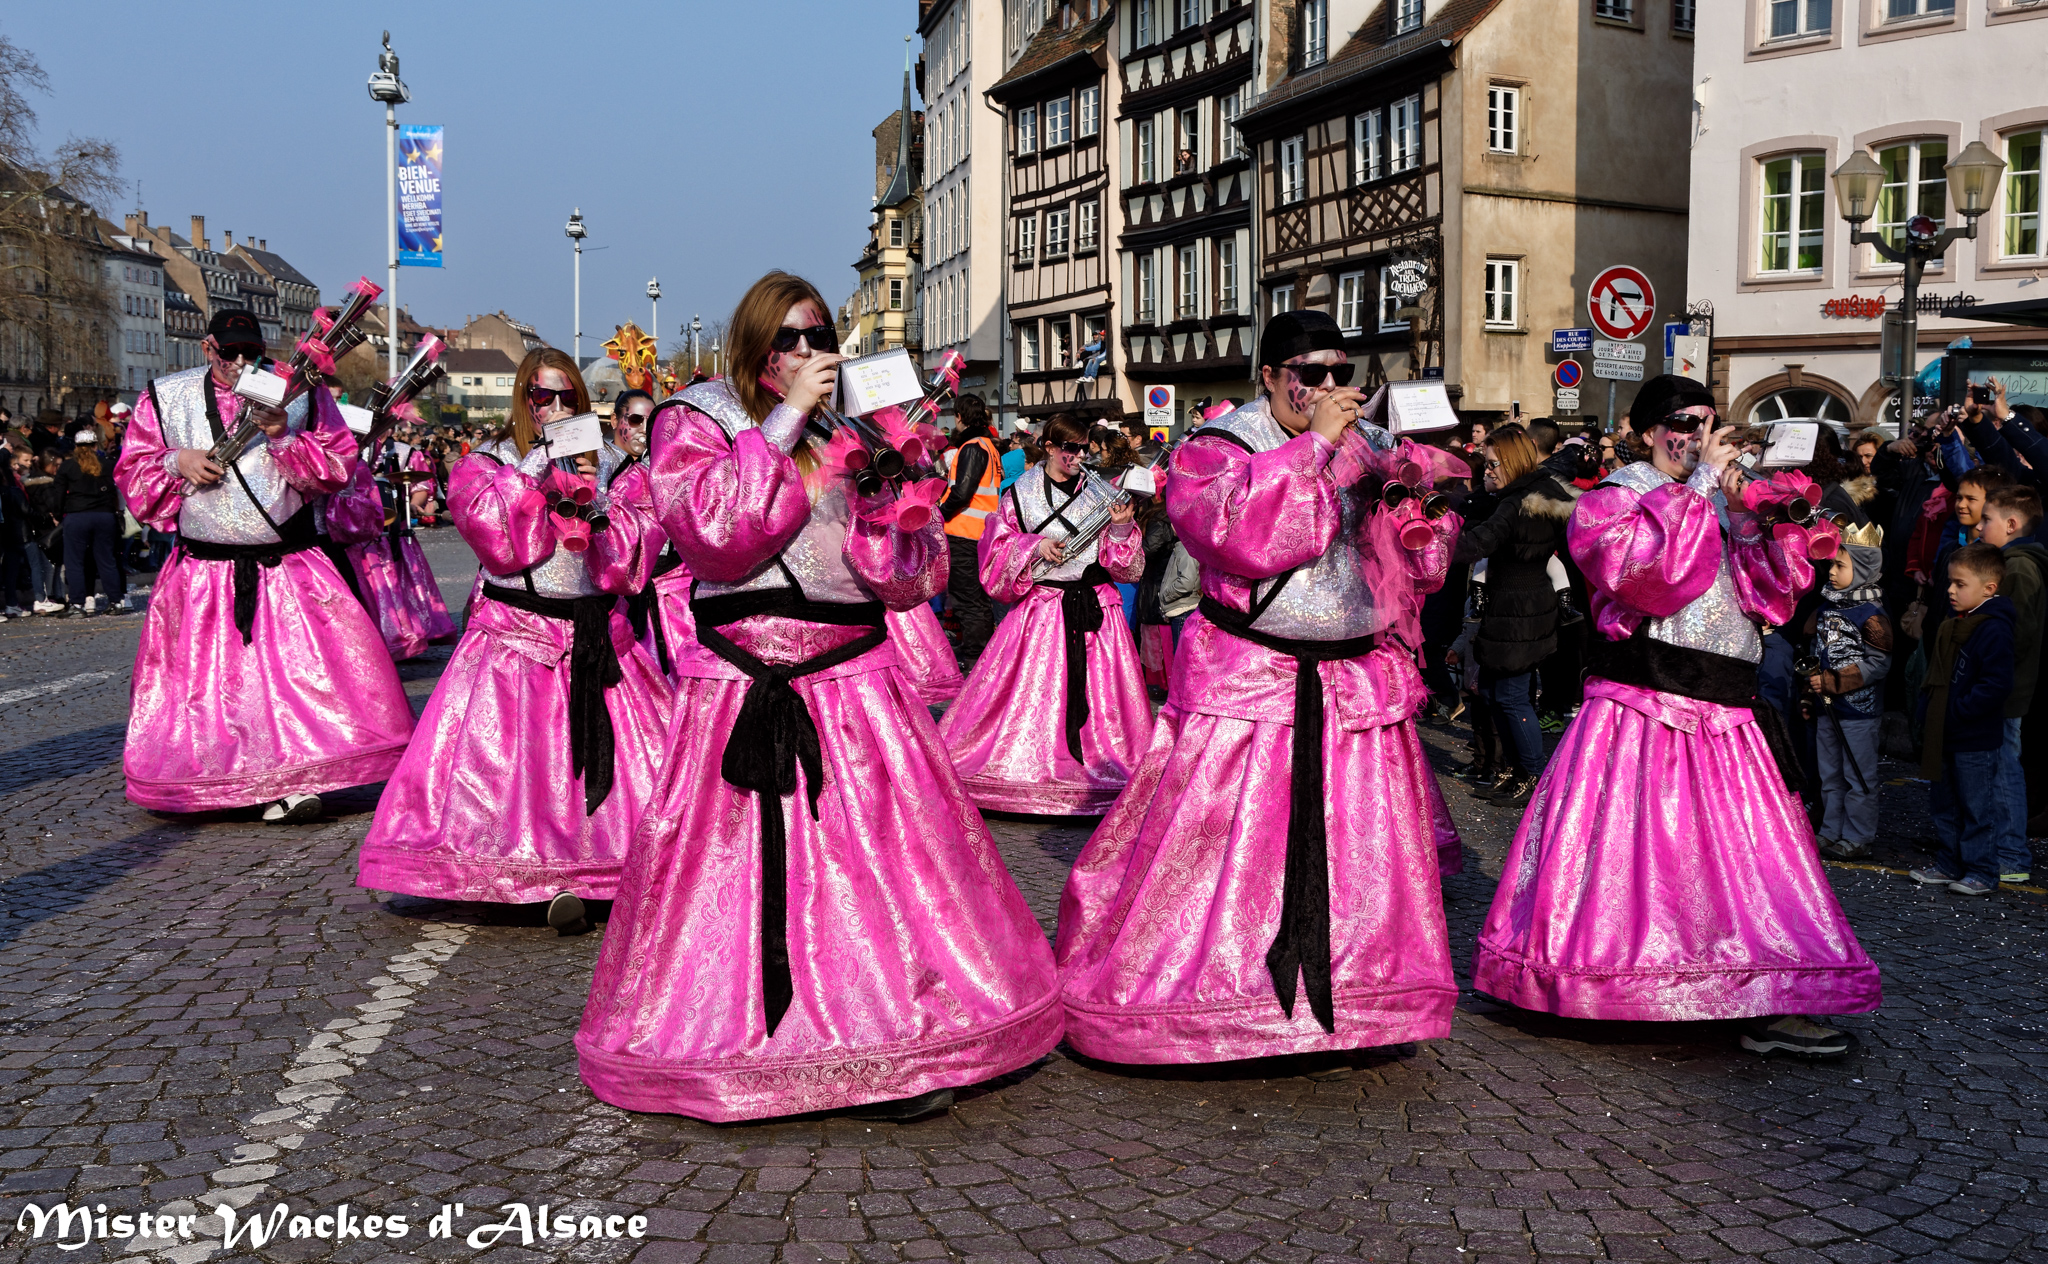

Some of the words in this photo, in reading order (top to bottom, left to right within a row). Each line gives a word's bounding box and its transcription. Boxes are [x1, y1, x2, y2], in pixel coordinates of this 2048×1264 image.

[398, 165, 432, 180] BIEN-
[400, 178, 440, 194] VENUE
[1390, 260, 1428, 277] Restaurant
[1400, 274, 1420, 283] TROIS
[1825, 294, 1886, 318] cuisine
